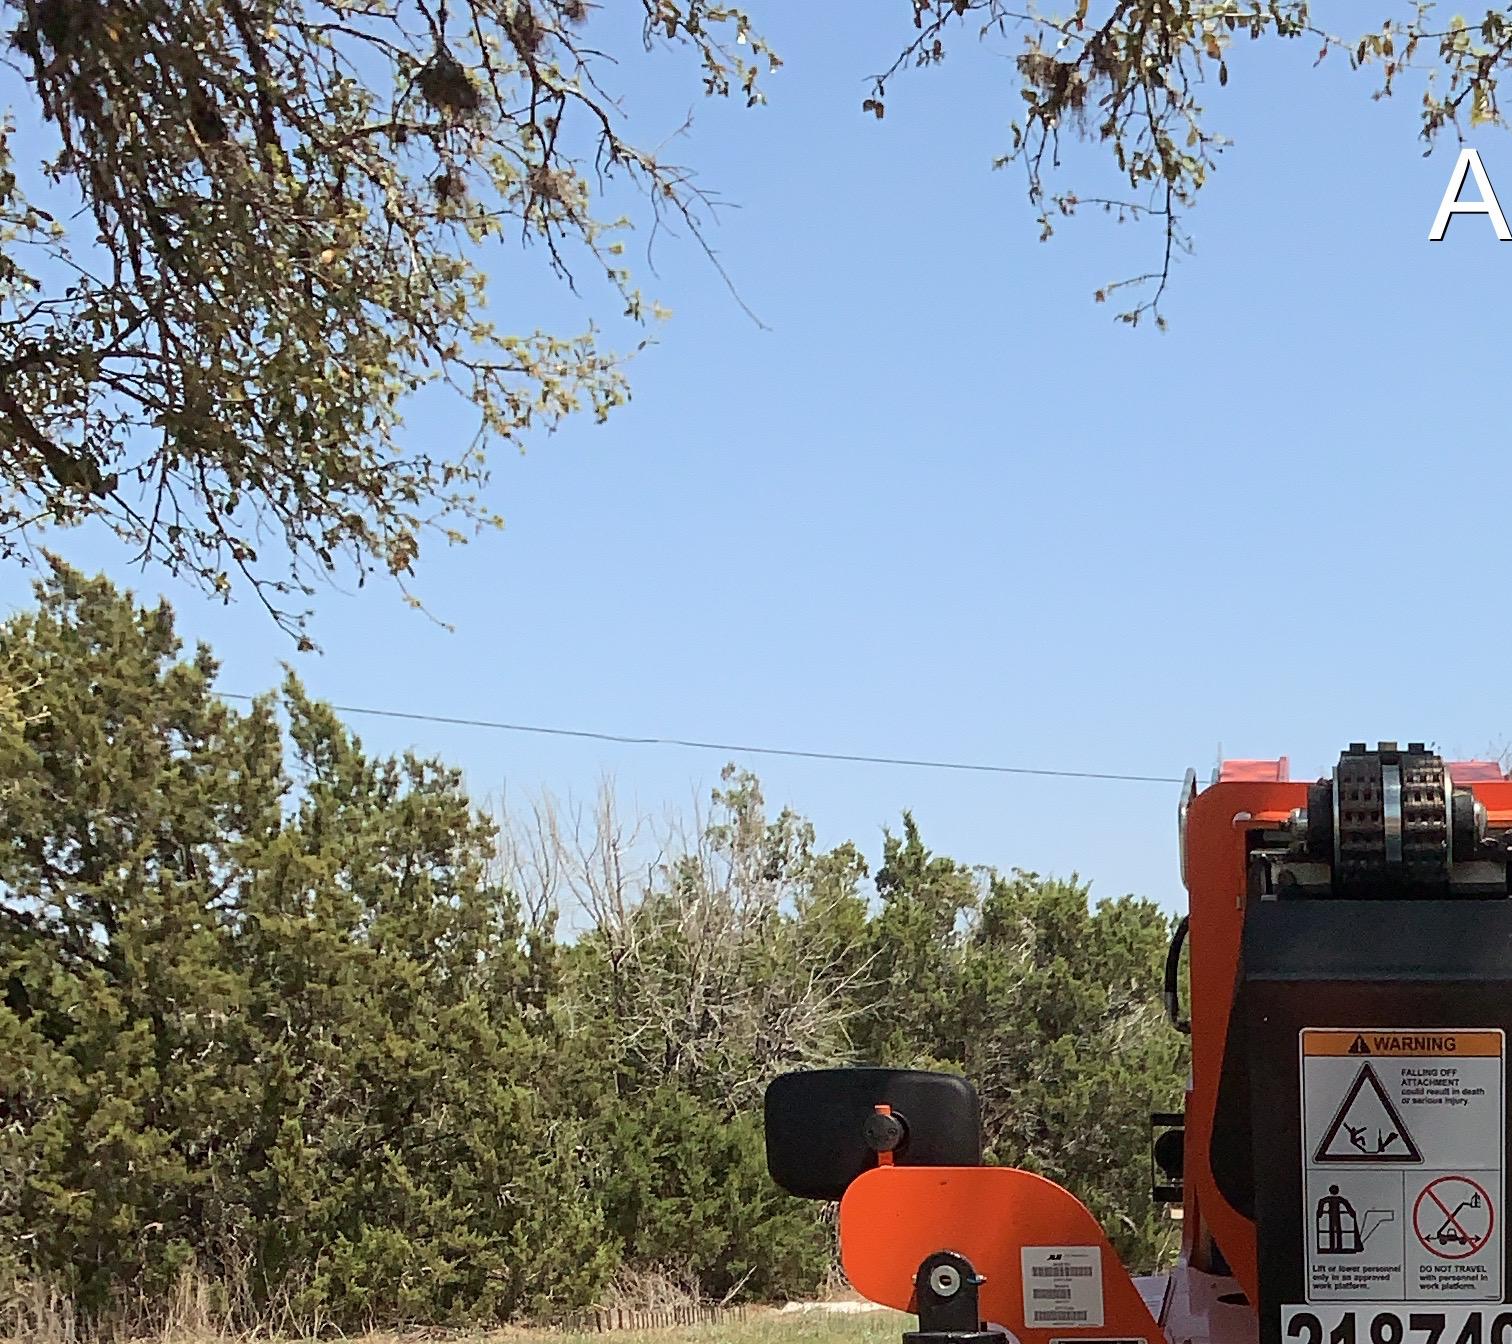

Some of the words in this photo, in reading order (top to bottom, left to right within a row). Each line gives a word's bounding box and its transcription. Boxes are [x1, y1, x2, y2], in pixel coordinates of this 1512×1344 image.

[1374, 1036, 1456, 1051] WARNING
[1420, 1265, 1433, 1273] DO
[1434, 1265, 1452, 1273] NOT
[1454, 1265, 1487, 1273] TRAVEL
